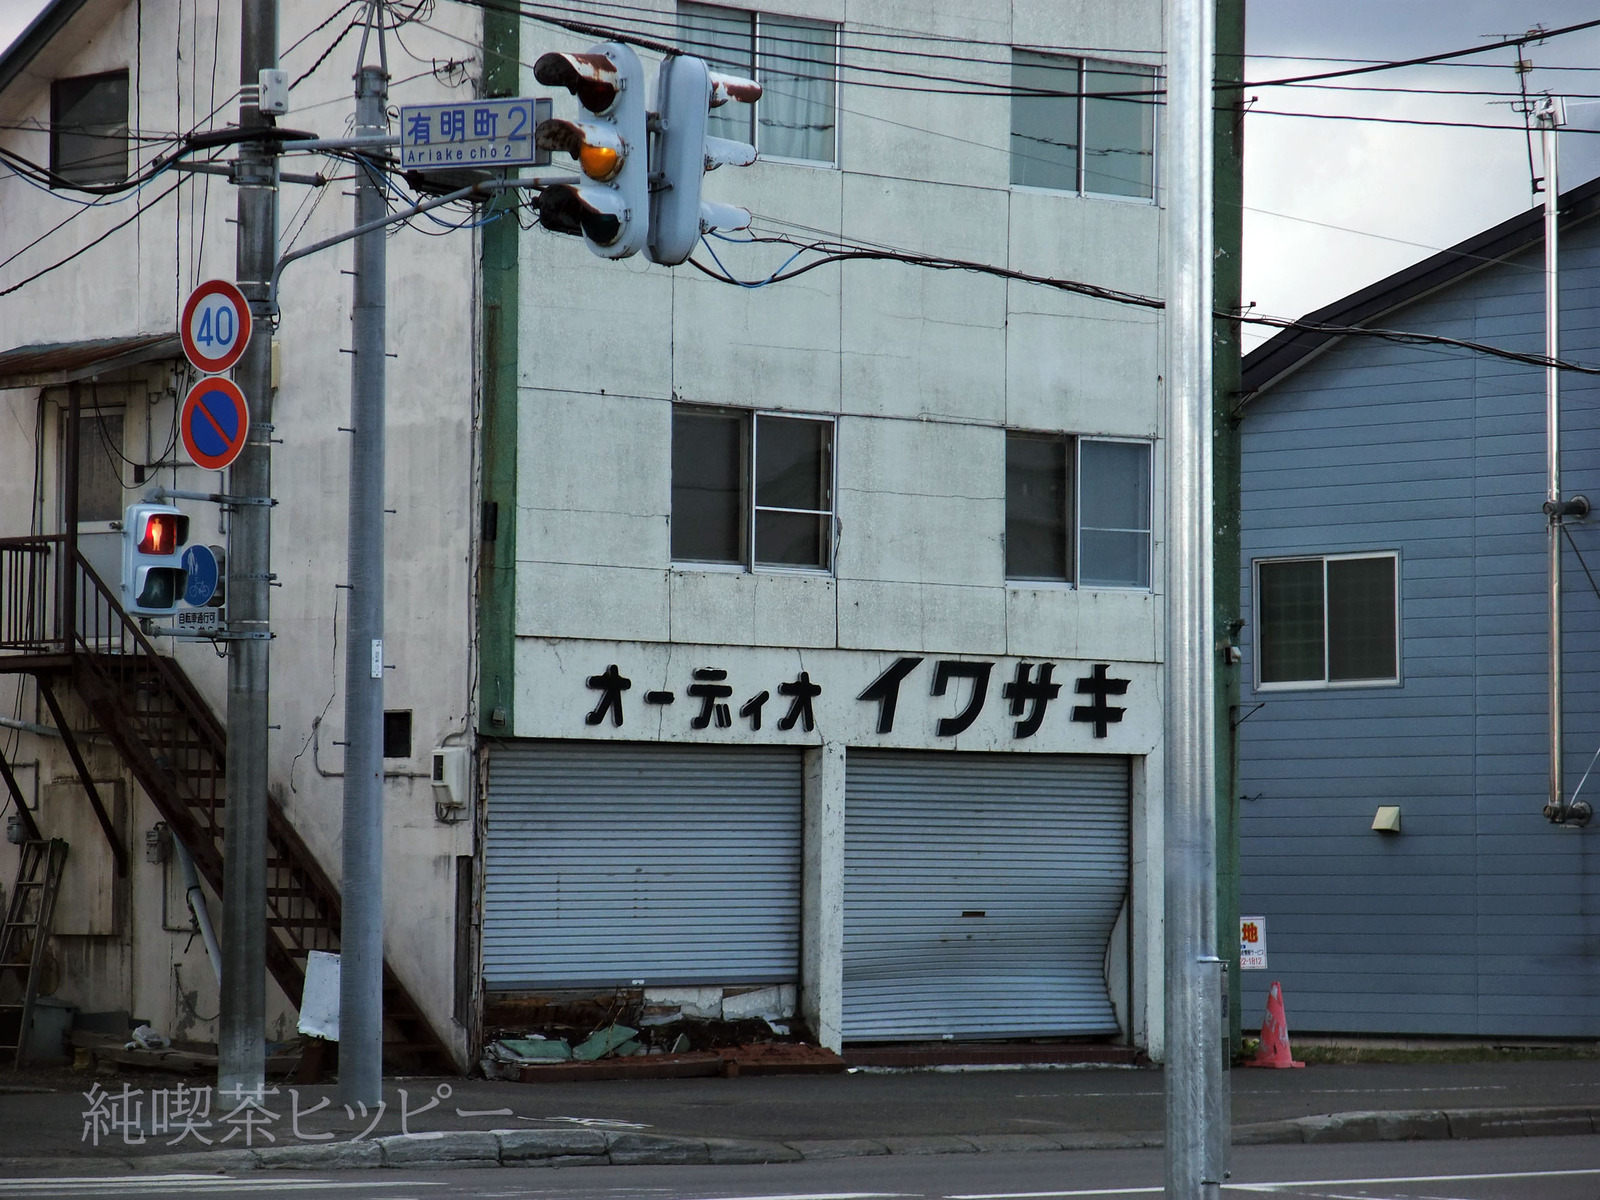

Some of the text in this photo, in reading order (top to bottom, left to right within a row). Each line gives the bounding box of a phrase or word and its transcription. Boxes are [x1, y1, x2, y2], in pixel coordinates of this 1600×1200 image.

[408, 106, 527, 145] 有明町2
[408, 144, 511, 162] Ariake cho 2
[197, 305, 233, 347] 40
[179, 612, 216, 624] 自転車通行可
[586, 657, 1132, 738] オーディオ イワサキ
[1242, 922, 1258, 943] 地
